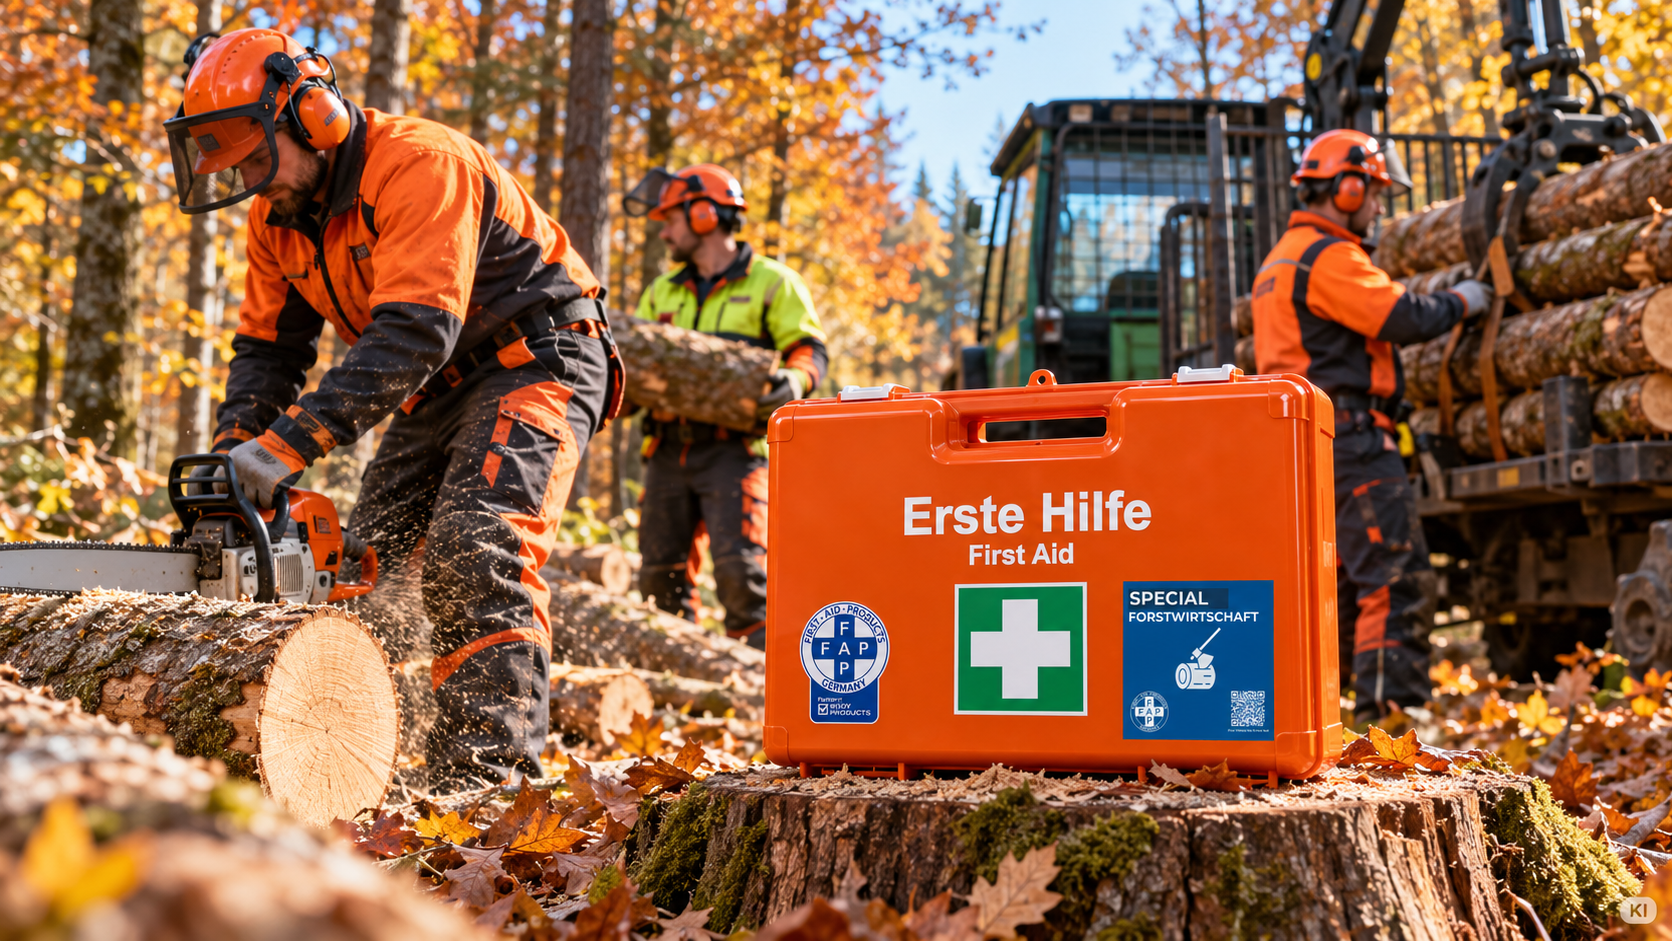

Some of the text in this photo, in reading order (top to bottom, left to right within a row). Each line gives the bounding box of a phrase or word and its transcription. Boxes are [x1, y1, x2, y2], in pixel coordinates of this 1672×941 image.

[903, 490, 1152, 536] Erste Hilfe
[969, 542, 1074, 566] First Aid
[1129, 590, 1209, 606] SPECIAL
[824, 605, 841, 618] AID
[1128, 611, 1259, 623] FORSTWIRTSCHAFT
[821, 678, 866, 692] GERMANY
